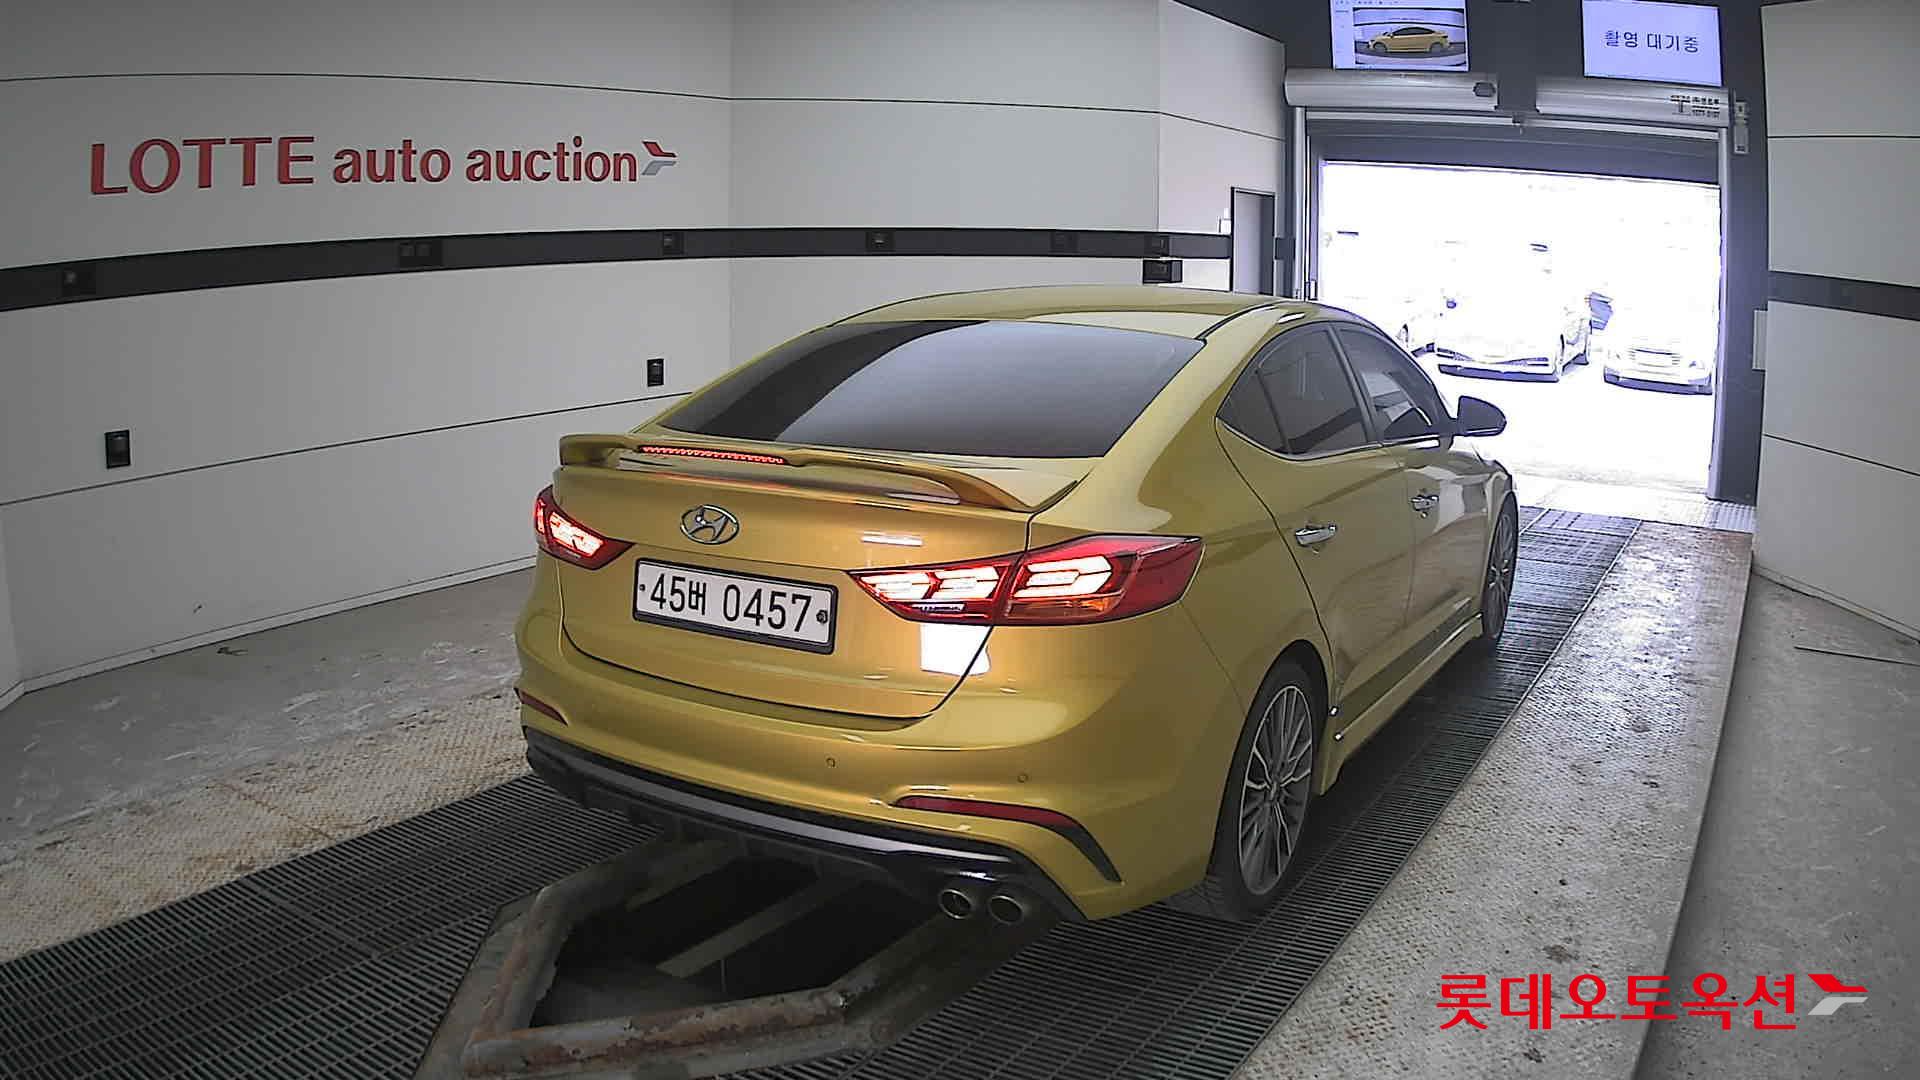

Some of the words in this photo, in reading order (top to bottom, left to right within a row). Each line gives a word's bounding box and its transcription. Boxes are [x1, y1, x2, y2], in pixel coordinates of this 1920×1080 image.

[1646, 33, 1698, 53] 대기중
[91, 136, 314, 195] LOTTE
[333, 138, 451, 183] auto
[465, 135, 638, 182] auction
[650, 573, 707, 616] 45버
[723, 584, 812, 633] 0457
